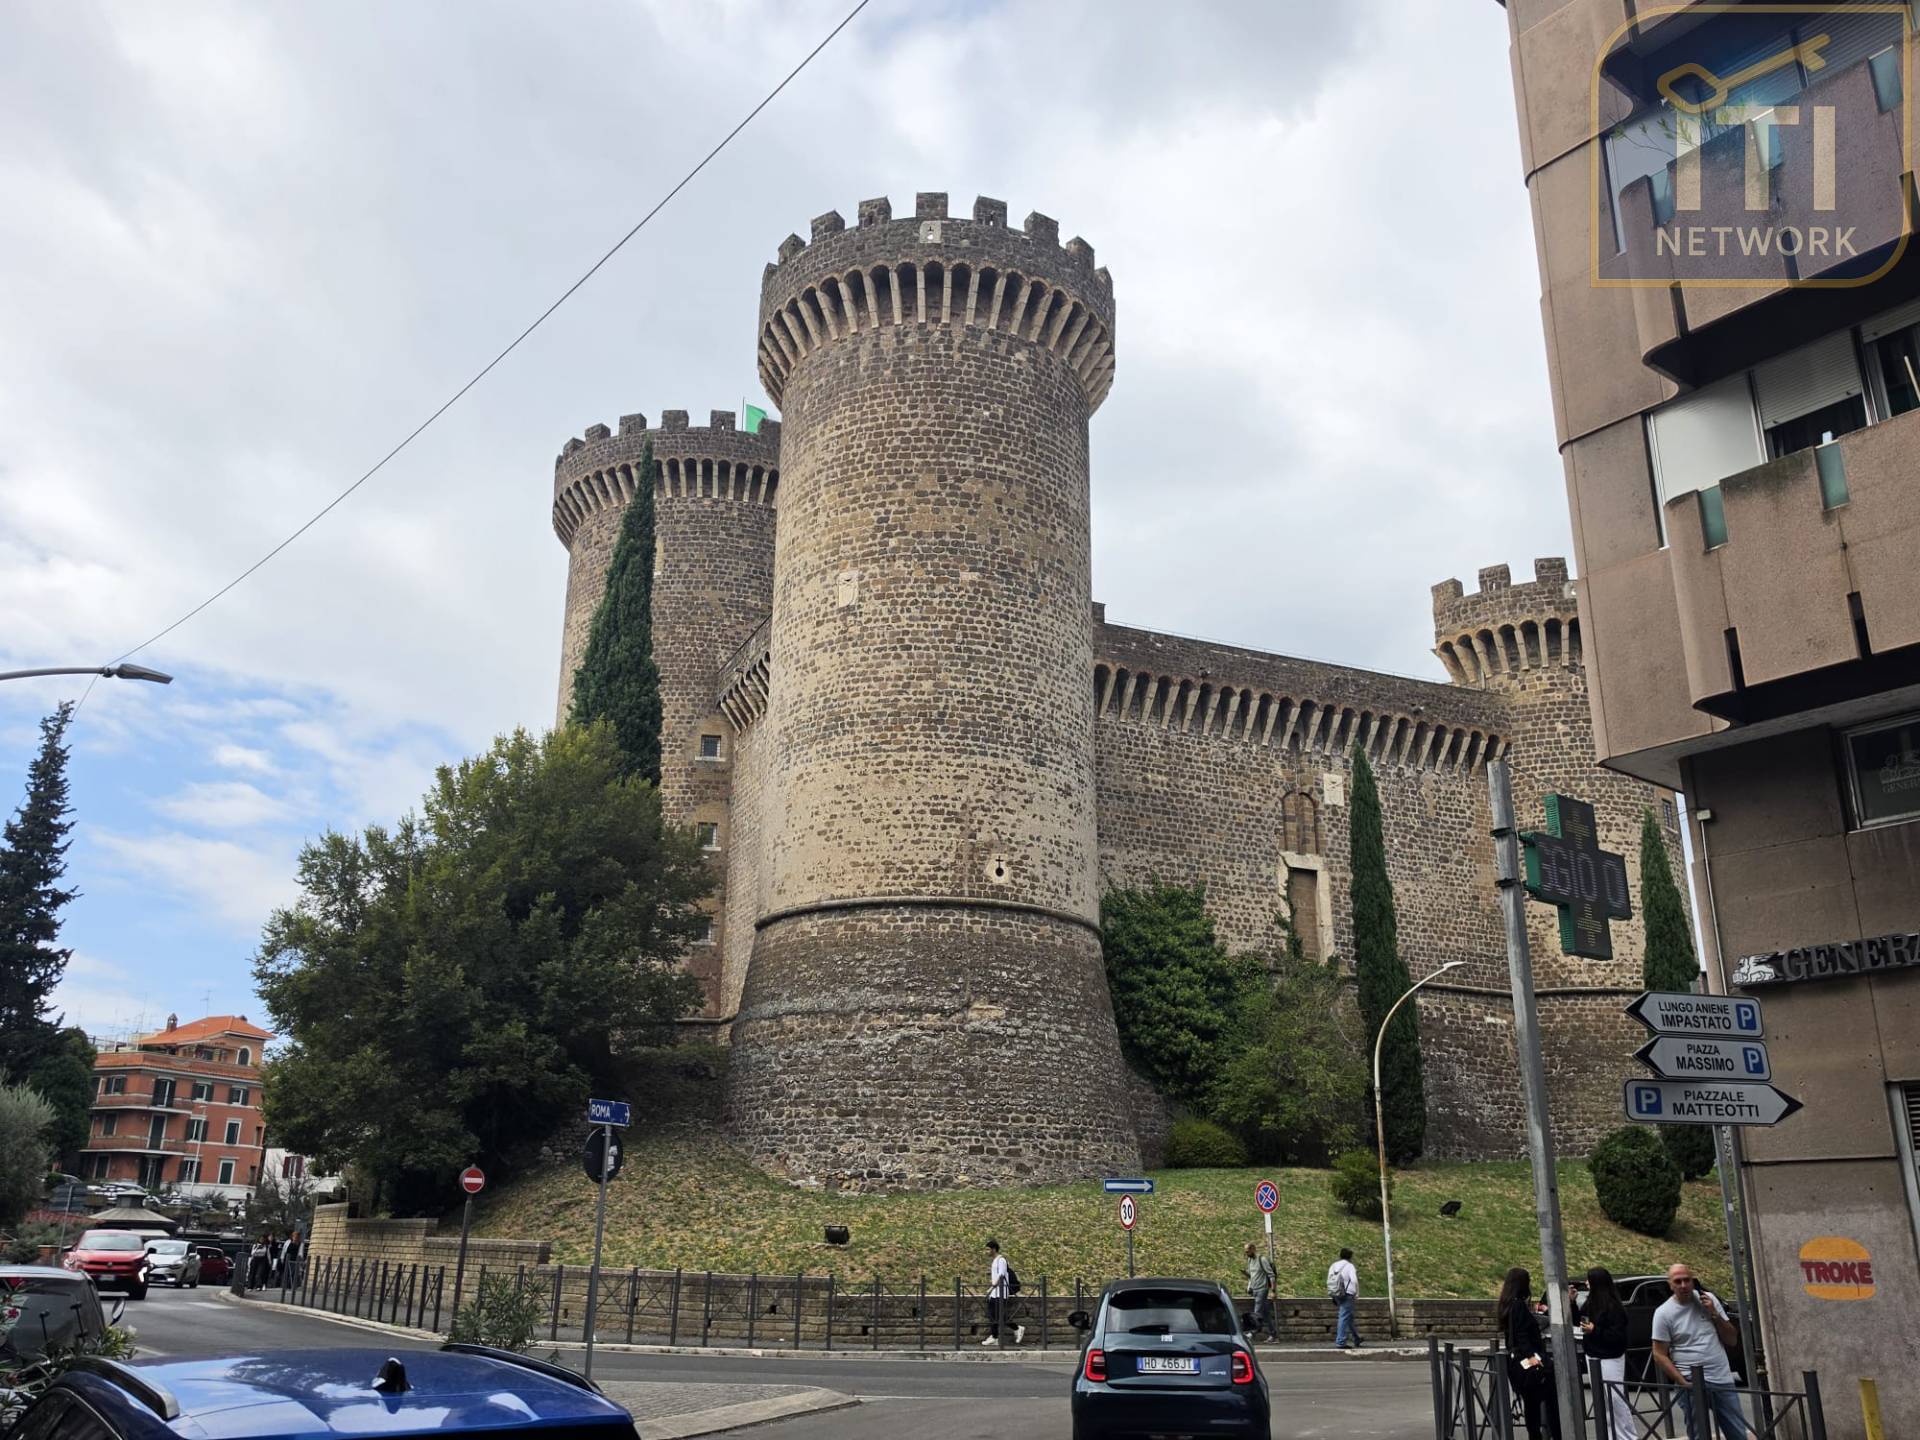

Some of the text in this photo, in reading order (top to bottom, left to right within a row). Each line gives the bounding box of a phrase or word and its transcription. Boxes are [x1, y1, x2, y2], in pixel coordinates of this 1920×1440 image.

[1658, 1001, 1730, 1015] LUNGO ANIENE
[1661, 1014, 1732, 1030] IMPASTATO
[1739, 1007, 1752, 1028] P
[1687, 1043, 1721, 1055] PIAZZA
[1675, 1056, 1735, 1072] MASSIMO
[1746, 1050, 1760, 1072] P
[1640, 1089, 1658, 1112] P
[1684, 1089, 1745, 1102] PIAZZALE
[590, 1104, 611, 1118] ROMA
[1672, 1102, 1760, 1118] MATTEOTTI
[1122, 1203, 1133, 1220] 30
[1800, 1261, 1874, 1285] TROKE
